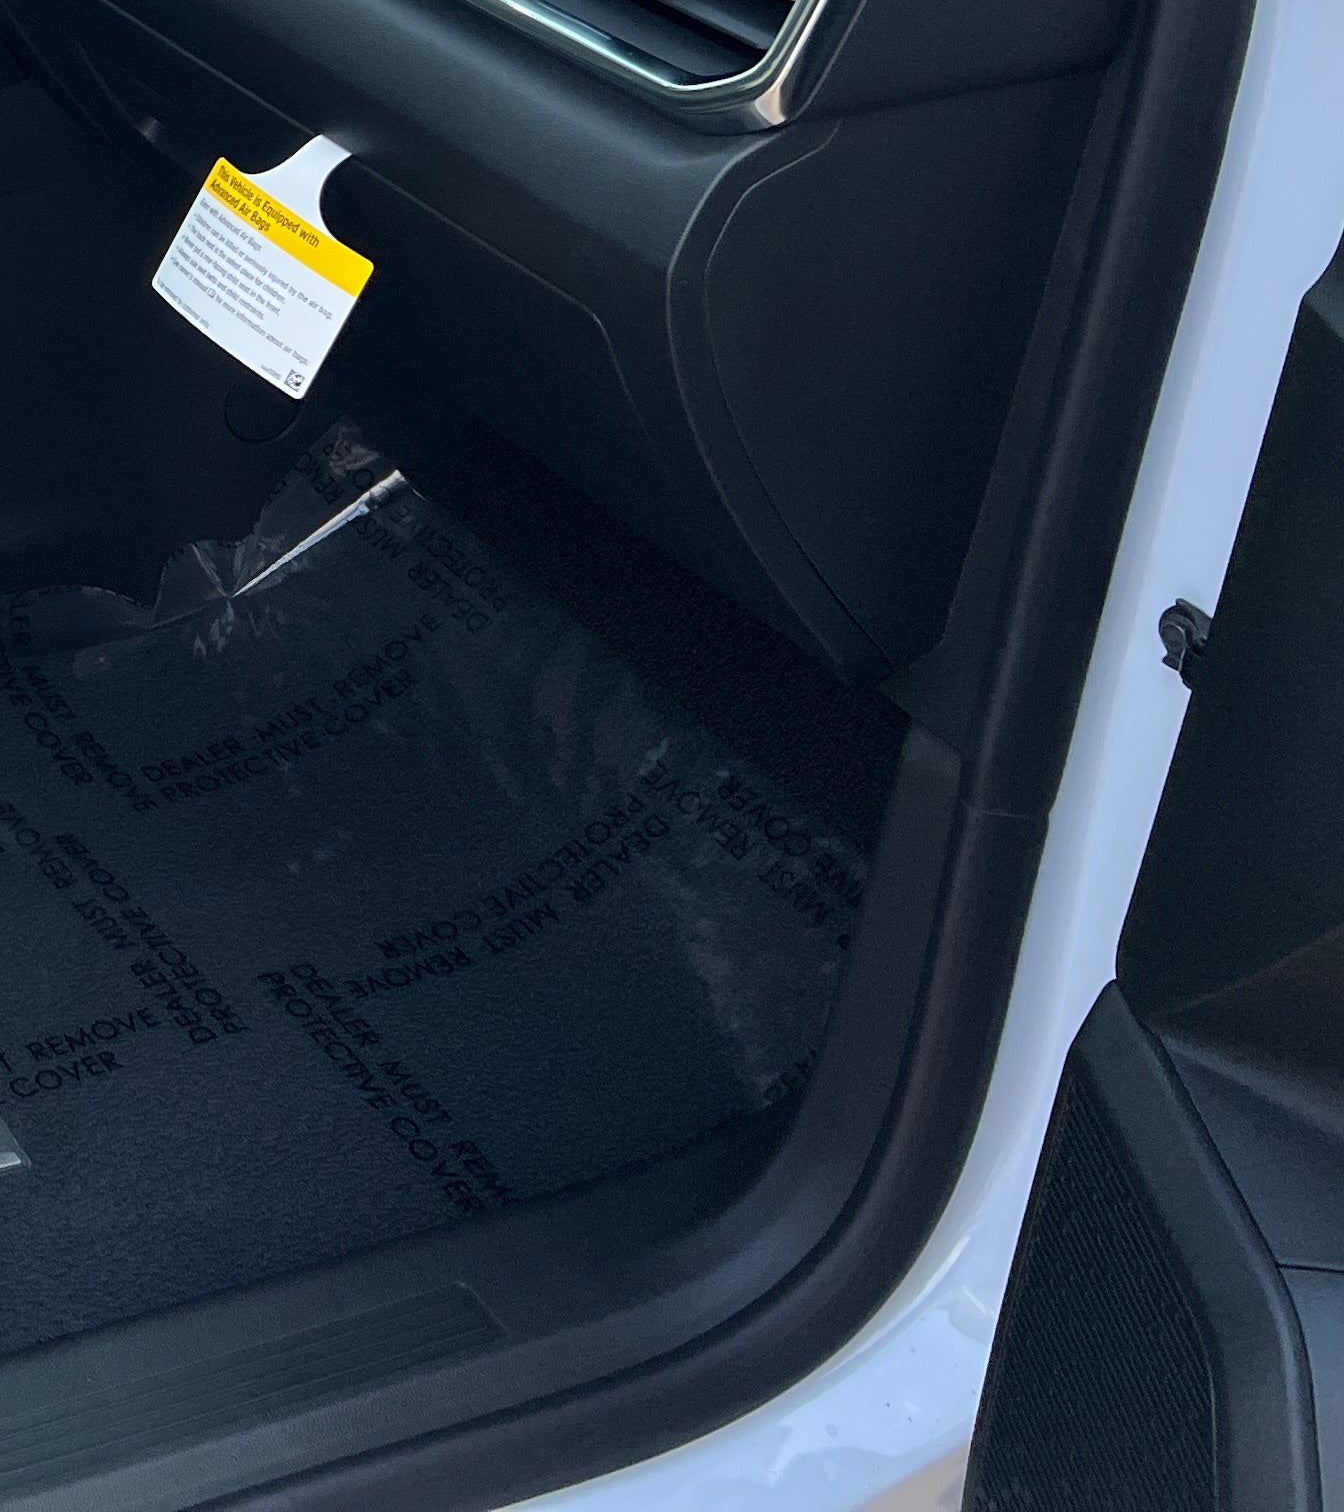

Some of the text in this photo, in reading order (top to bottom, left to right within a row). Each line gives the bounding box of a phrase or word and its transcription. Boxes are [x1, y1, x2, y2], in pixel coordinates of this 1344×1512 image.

[229, 176, 253, 201] Vehicle
[261, 200, 300, 233] Equipped
[299, 229, 319, 247] with
[238, 202, 251, 216] Air
[250, 210, 271, 231] Bags
[141, 612, 441, 784] DEALER MUST REMOVE
[160, 668, 419, 805] PROTECTIVE COVER
[23, 711, 94, 787] COVER
[69, 730, 159, 813] REMOVE
[344, 813, 671, 999] DEALER MUST REMOVE
[374, 792, 645, 960] PROTECTIVE COVER
[55, 833, 252, 1036] PROTECTIVE COVER
[70, 898, 139, 950] MUST
[25, 1007, 163, 1063] REMOVE
[129, 958, 218, 1045] DEALER
[289, 962, 380, 1048] DEALER
[376, 1060, 454, 1124] MUST
[8, 1049, 125, 1099] COVER
[256, 970, 485, 1214] PROTECTIVE COVER
